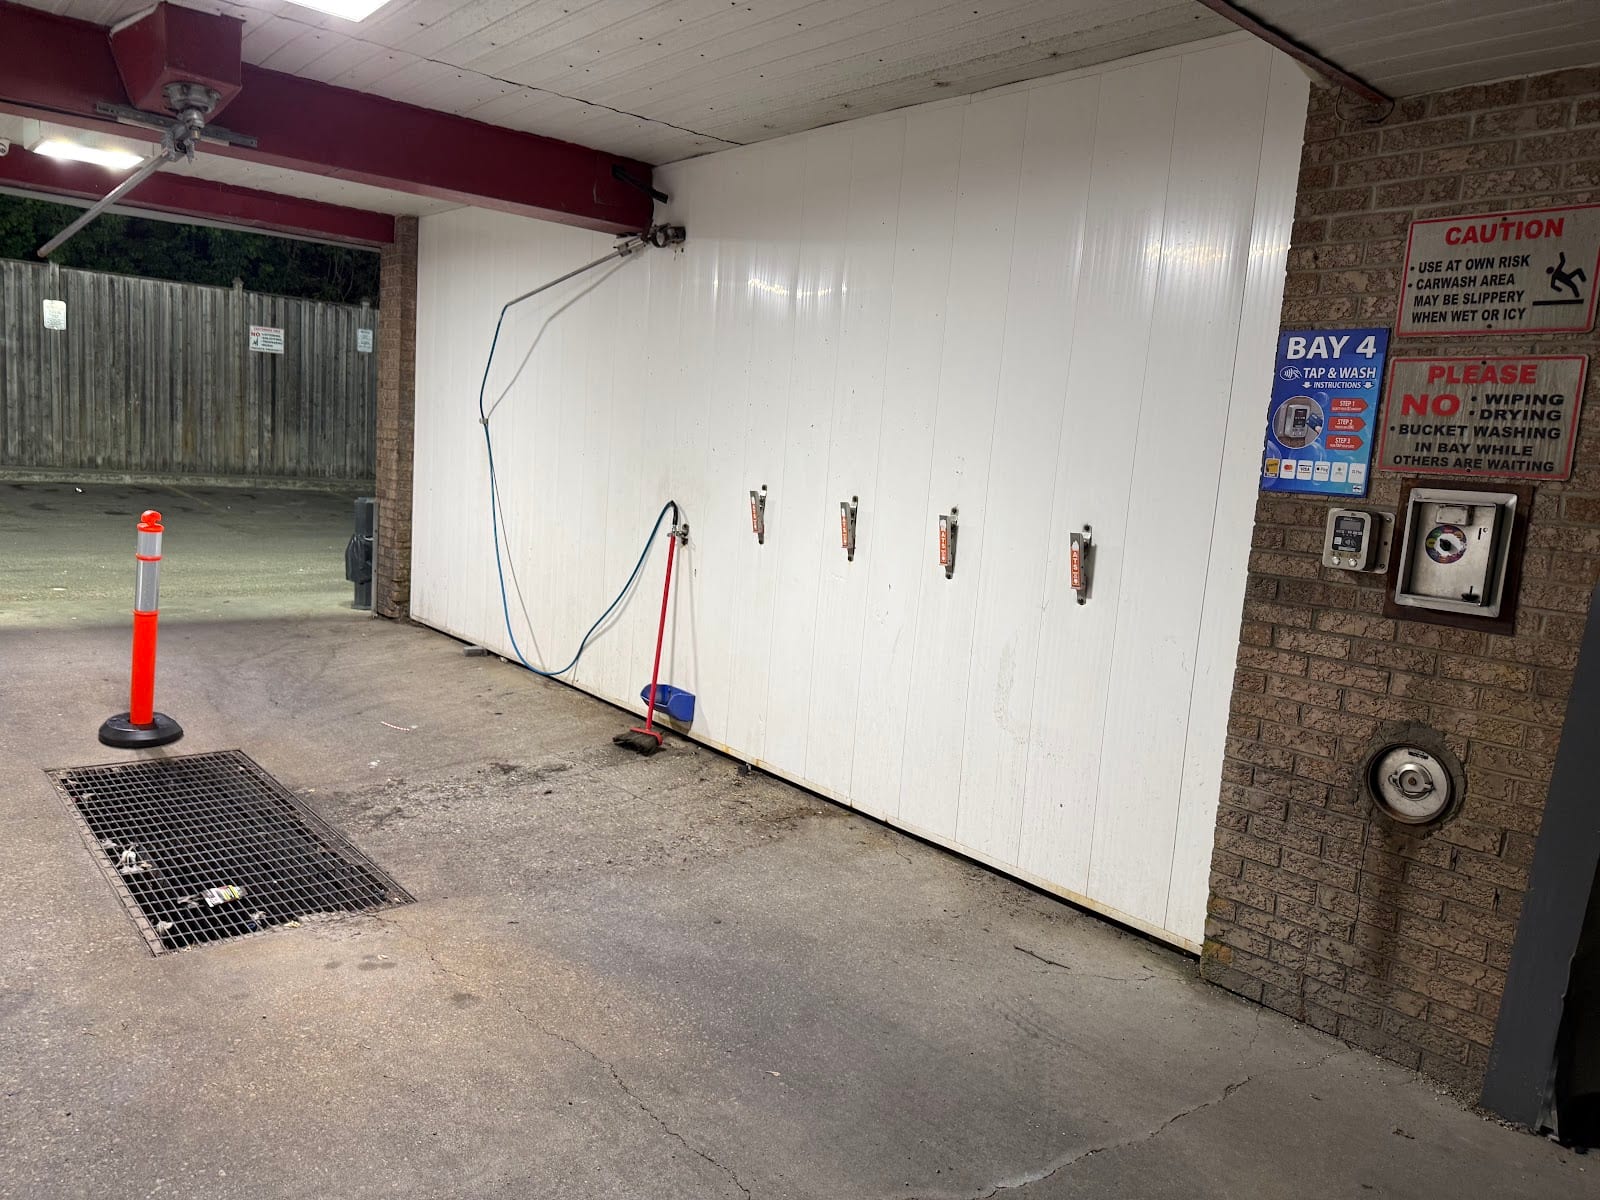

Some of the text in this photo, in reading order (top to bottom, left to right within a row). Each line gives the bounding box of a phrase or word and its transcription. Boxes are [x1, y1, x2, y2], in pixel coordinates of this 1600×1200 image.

[1445, 217, 1564, 245] CAUTION
[1418, 255, 1531, 273] USE AT OWN RISK
[1416, 273, 1515, 290] CARWASH AREA
[1413, 290, 1525, 307] MAY BE SLIPPERY
[1412, 307, 1527, 324] WHEN WET OR ICY
[1286, 335, 1376, 360] BAY 4
[1303, 367, 1376, 379] TAP & WASH
[1427, 364, 1538, 385] PLEASE
[1313, 381, 1362, 389] INSTRUCTIONS
[1400, 393, 1460, 417] NO
[1485, 394, 1565, 406] WIPING
[1480, 409, 1562, 421] DRYING
[1398, 424, 1561, 439] BUCKET WASHING
[1414, 442, 1533, 456] IN BAY WHILE
[1393, 455, 1554, 472] OTHERS ARE WAITING
